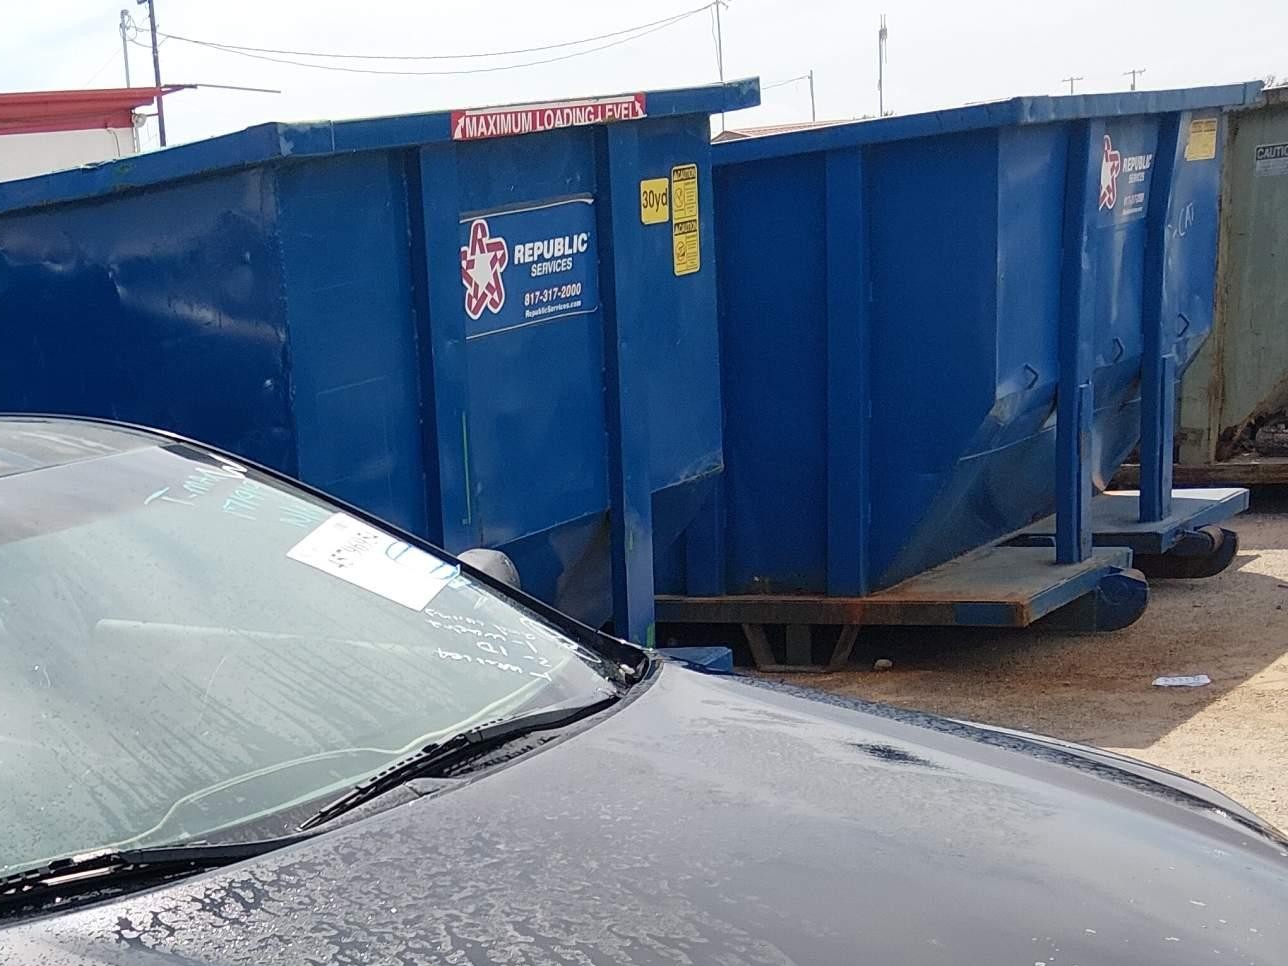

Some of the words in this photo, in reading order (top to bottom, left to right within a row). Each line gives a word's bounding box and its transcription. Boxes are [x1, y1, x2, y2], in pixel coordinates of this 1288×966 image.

[465, 112, 533, 138] MAXIMUM
[536, 104, 594, 131] LOADING
[642, 188, 668, 212] 30yd
[514, 233, 588, 265] REPUBLIC
[531, 257, 573, 277] SERVICES
[524, 282, 582, 306] 817-317-2000
